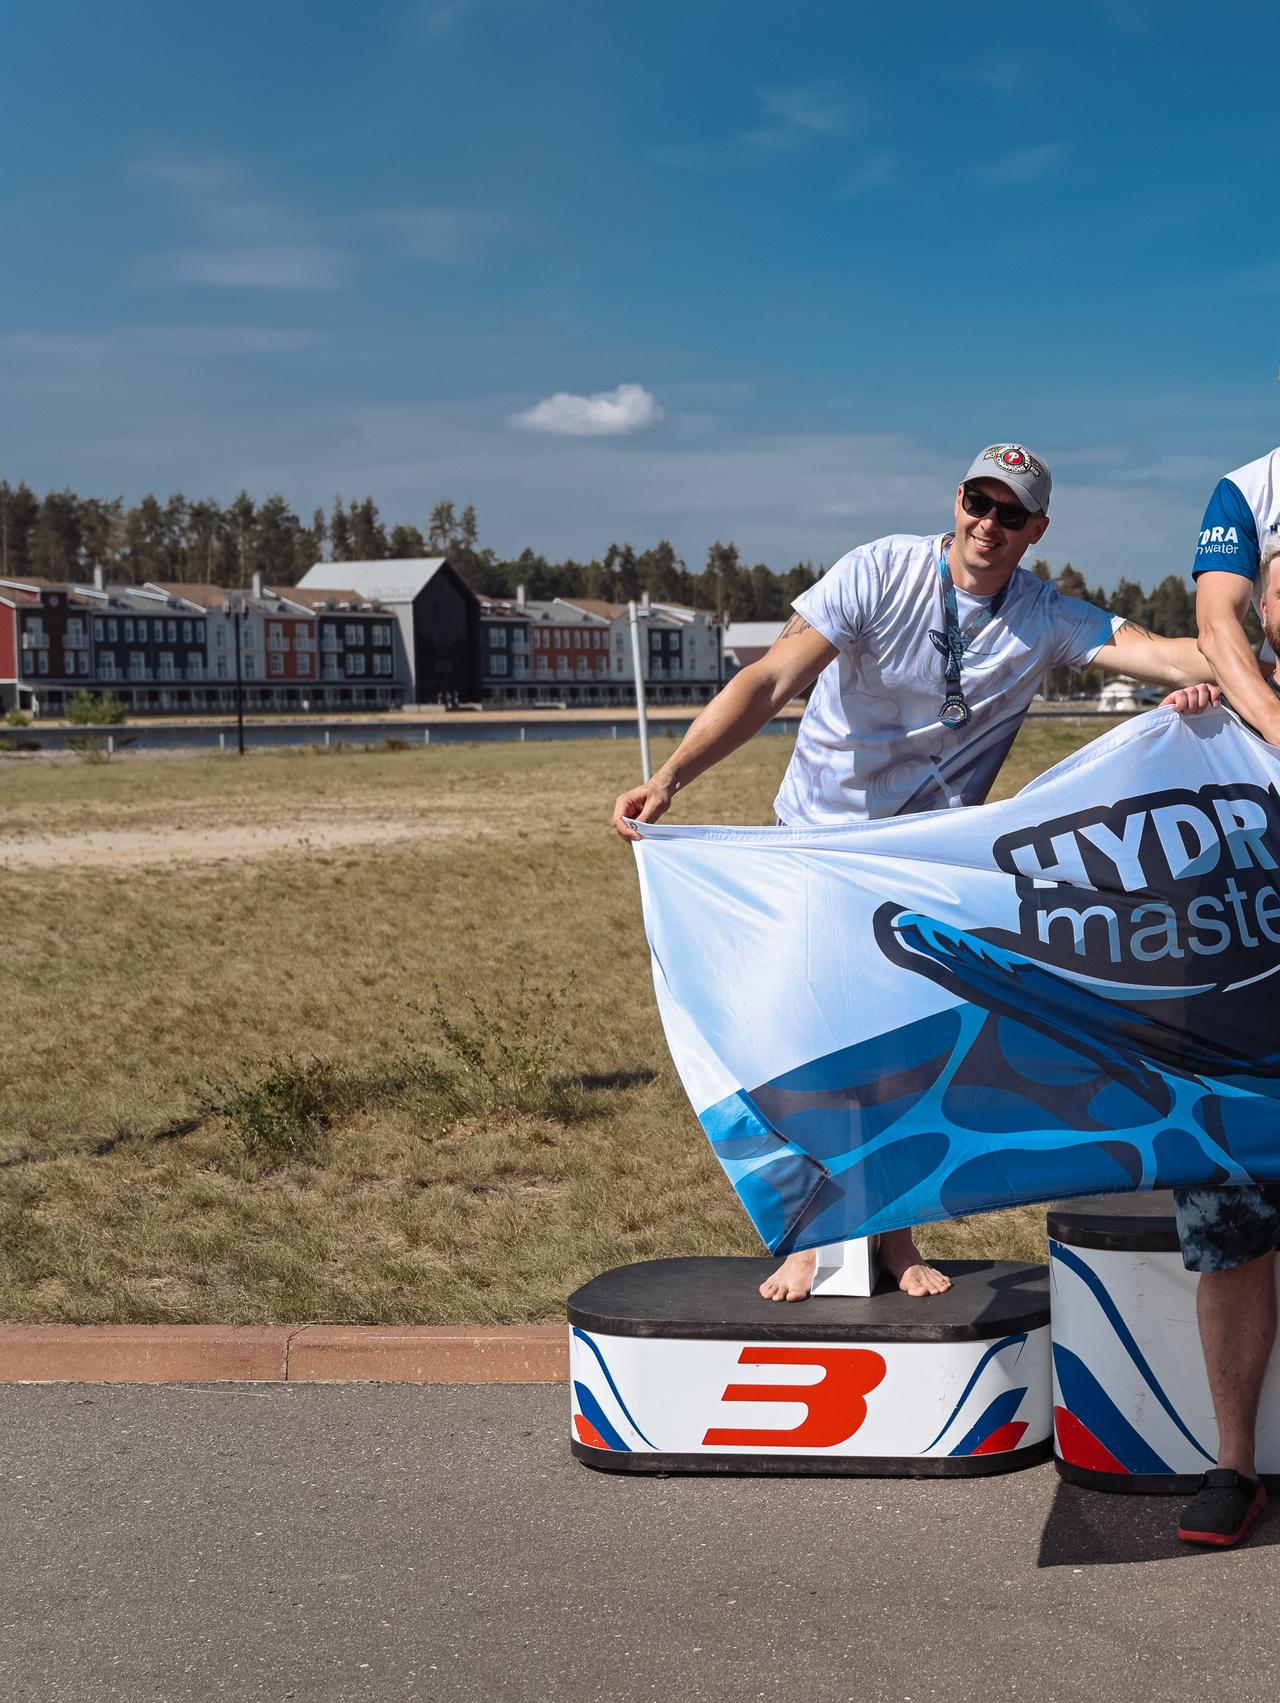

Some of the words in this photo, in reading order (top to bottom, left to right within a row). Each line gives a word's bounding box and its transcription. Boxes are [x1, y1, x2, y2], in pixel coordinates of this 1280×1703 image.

[1009, 452, 1019, 461] P
[1205, 543, 1239, 554] water
[702, 1346, 887, 1448] 3
